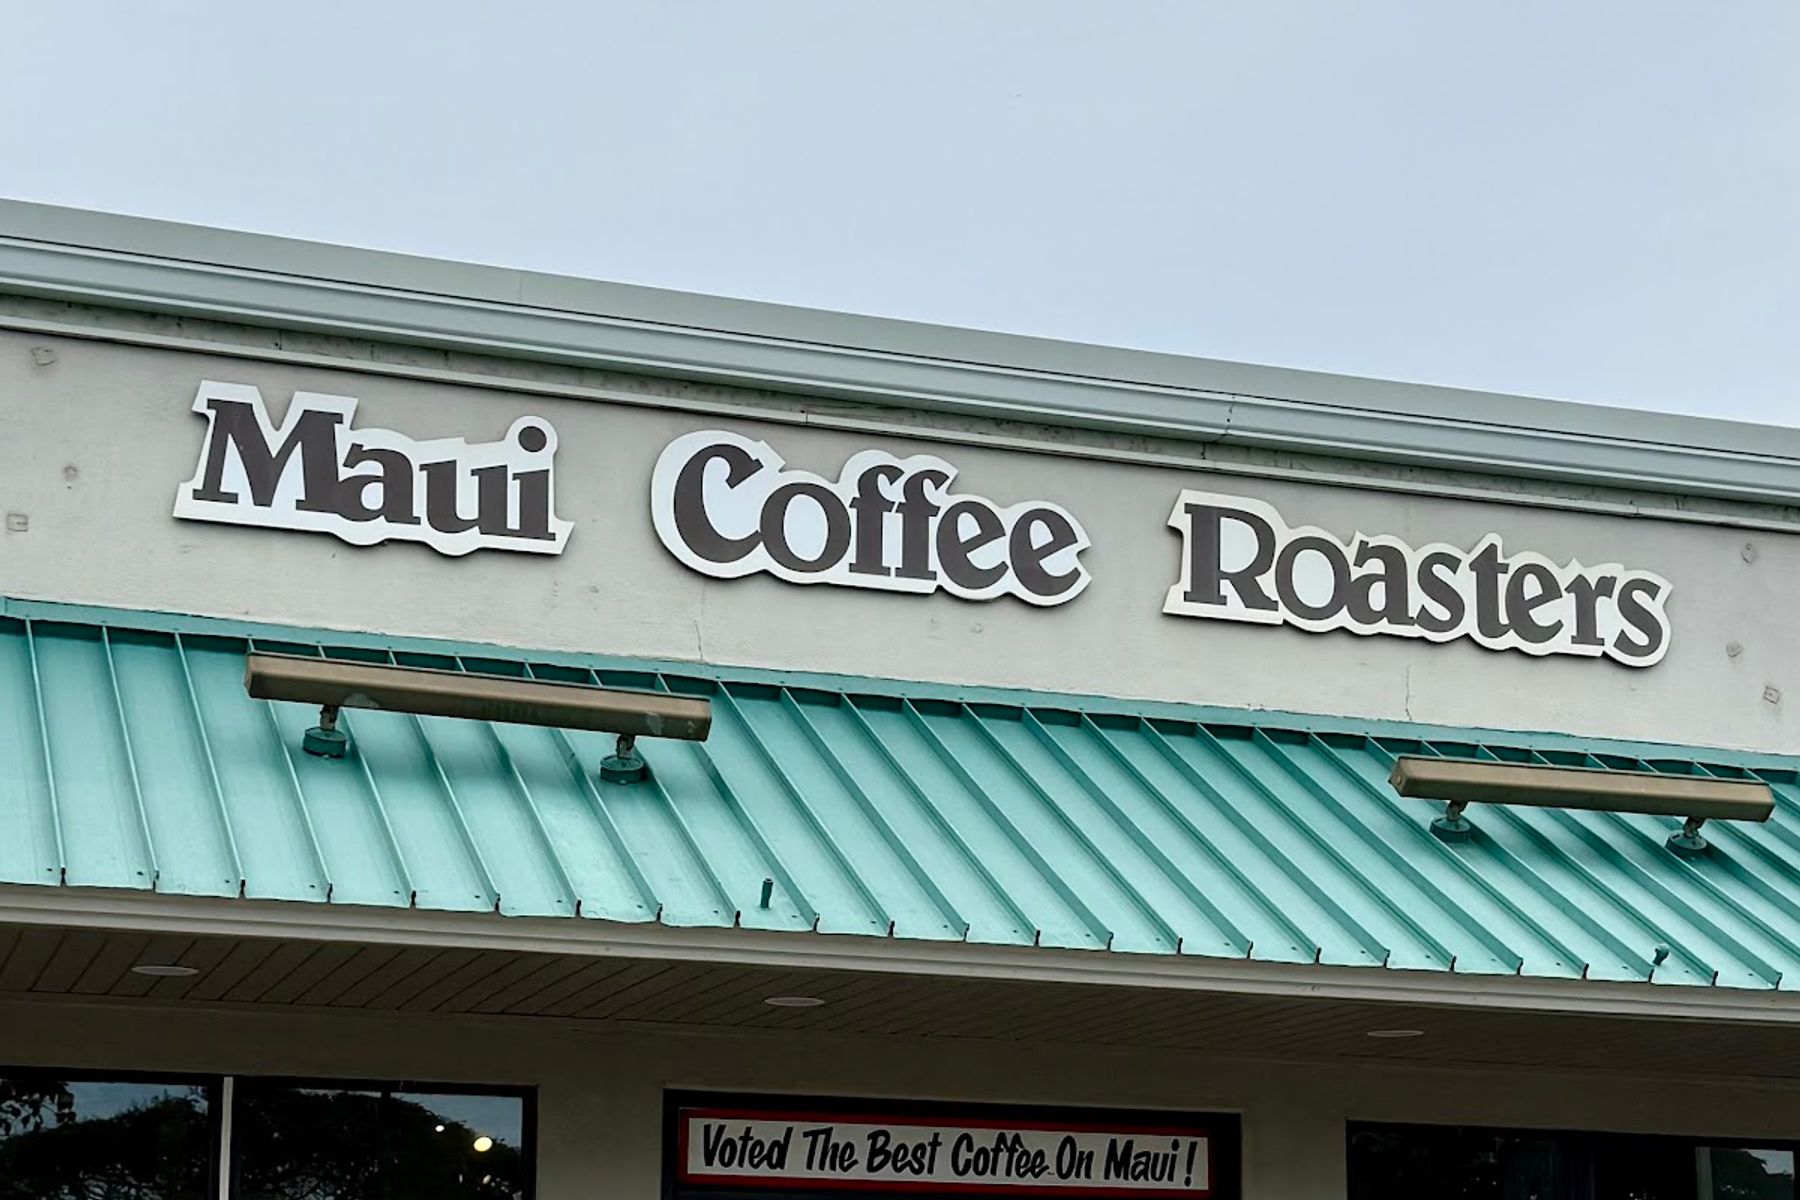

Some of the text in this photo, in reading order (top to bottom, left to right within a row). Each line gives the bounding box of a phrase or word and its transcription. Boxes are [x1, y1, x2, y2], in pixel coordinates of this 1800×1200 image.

[192, 399, 1662, 657] Maui Coffee Roasters
[703, 1124, 793, 1170] Voted
[803, 1127, 859, 1172] The
[866, 1130, 943, 1176] Best
[951, 1132, 1049, 1179] Coffee
[1056, 1135, 1094, 1180] On
